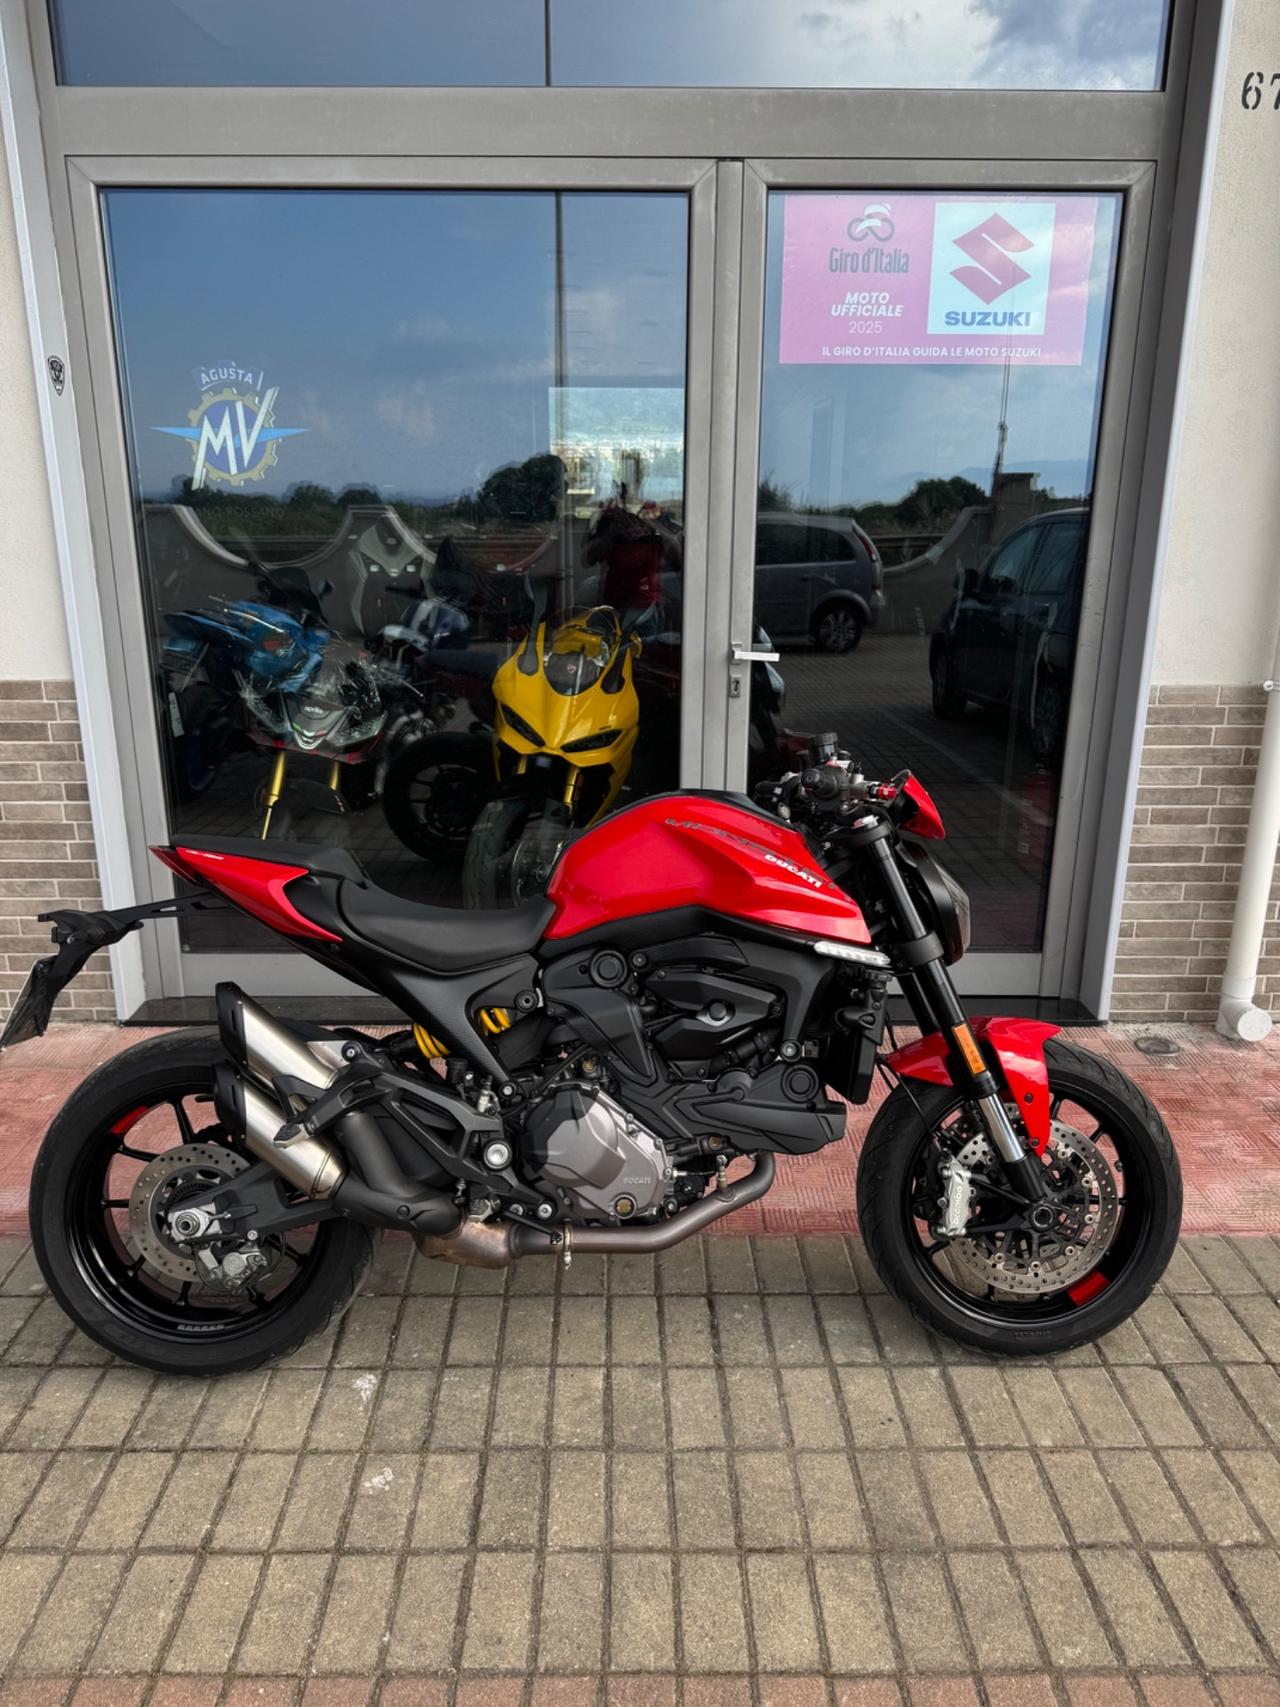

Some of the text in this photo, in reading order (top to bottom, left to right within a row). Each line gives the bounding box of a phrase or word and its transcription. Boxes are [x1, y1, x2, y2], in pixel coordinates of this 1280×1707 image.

[828, 247, 910, 273] Giro d'Italia
[844, 292, 890, 305] MOTO
[831, 304, 903, 317] UFFICIALE
[944, 311, 1032, 327] SUZUKI
[848, 321, 883, 334] 2025
[821, 346, 1041, 358] IL GIRO D'ITALIA GUIDA LE MOTO SUZUKI
[201, 367, 254, 385] AGUSTA
[192, 386, 277, 491] MV
[763, 853, 824, 889] DUCATI
